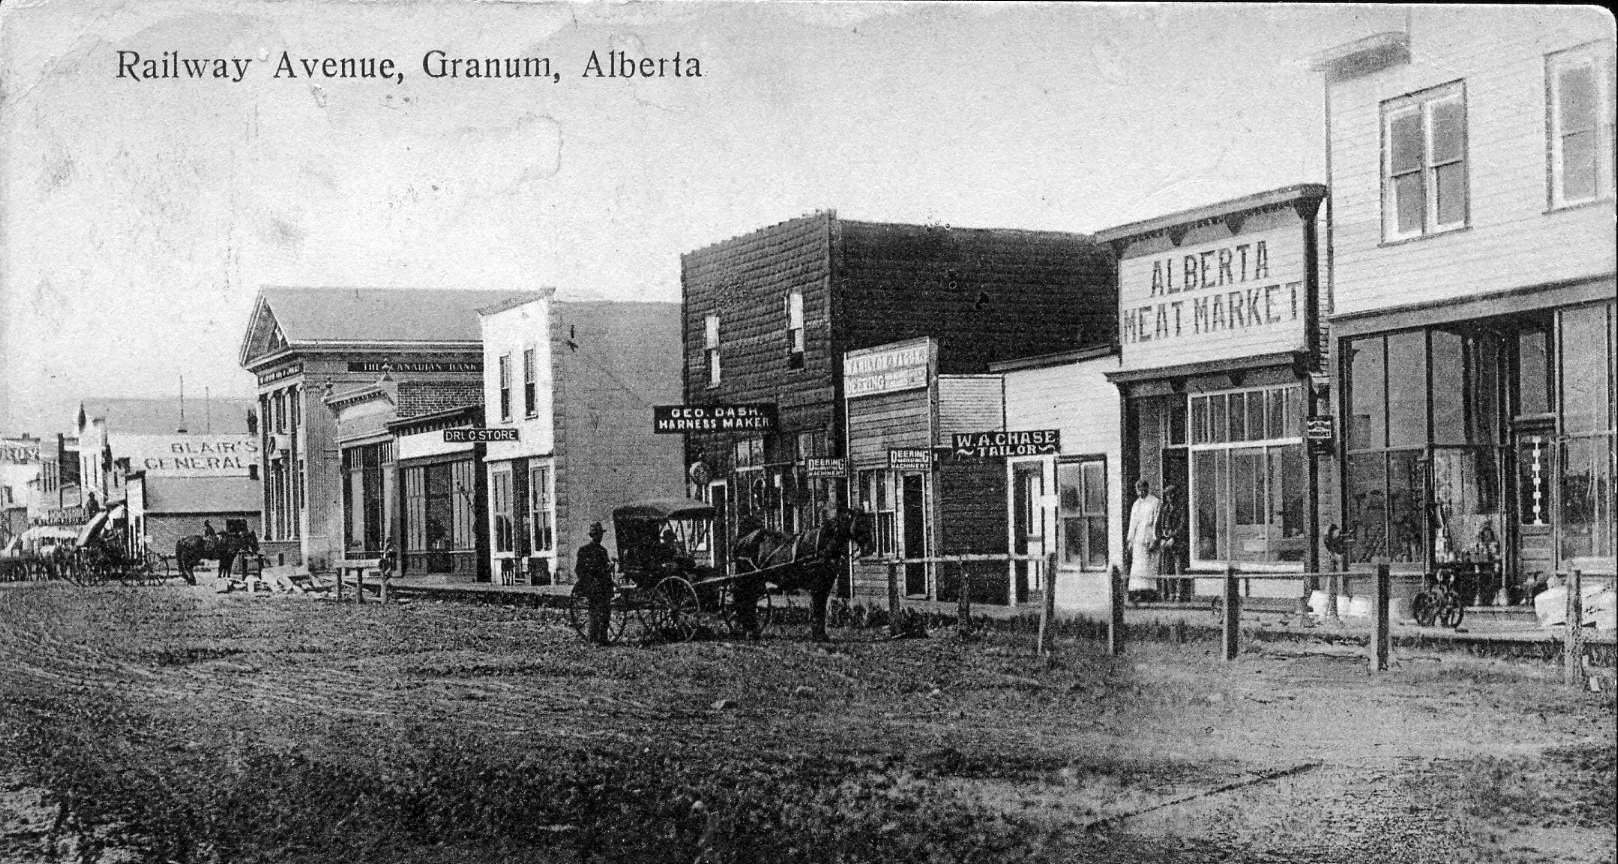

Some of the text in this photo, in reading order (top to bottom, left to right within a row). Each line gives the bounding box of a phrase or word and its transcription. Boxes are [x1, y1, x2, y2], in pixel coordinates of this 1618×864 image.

[1151, 240, 1269, 298] ALBERTA
[1123, 280, 1302, 344] MEAT MARKET
[671, 408, 709, 418] GEO.
[659, 418, 717, 429] HARNESS
[479, 430, 516, 440] STORE
[171, 441, 259, 453] BLAIR'S
[977, 444, 1037, 457] TAILOR
[891, 450, 929, 463] DEERING
[144, 456, 248, 470] GENERAL
[808, 459, 844, 471] DEERING
